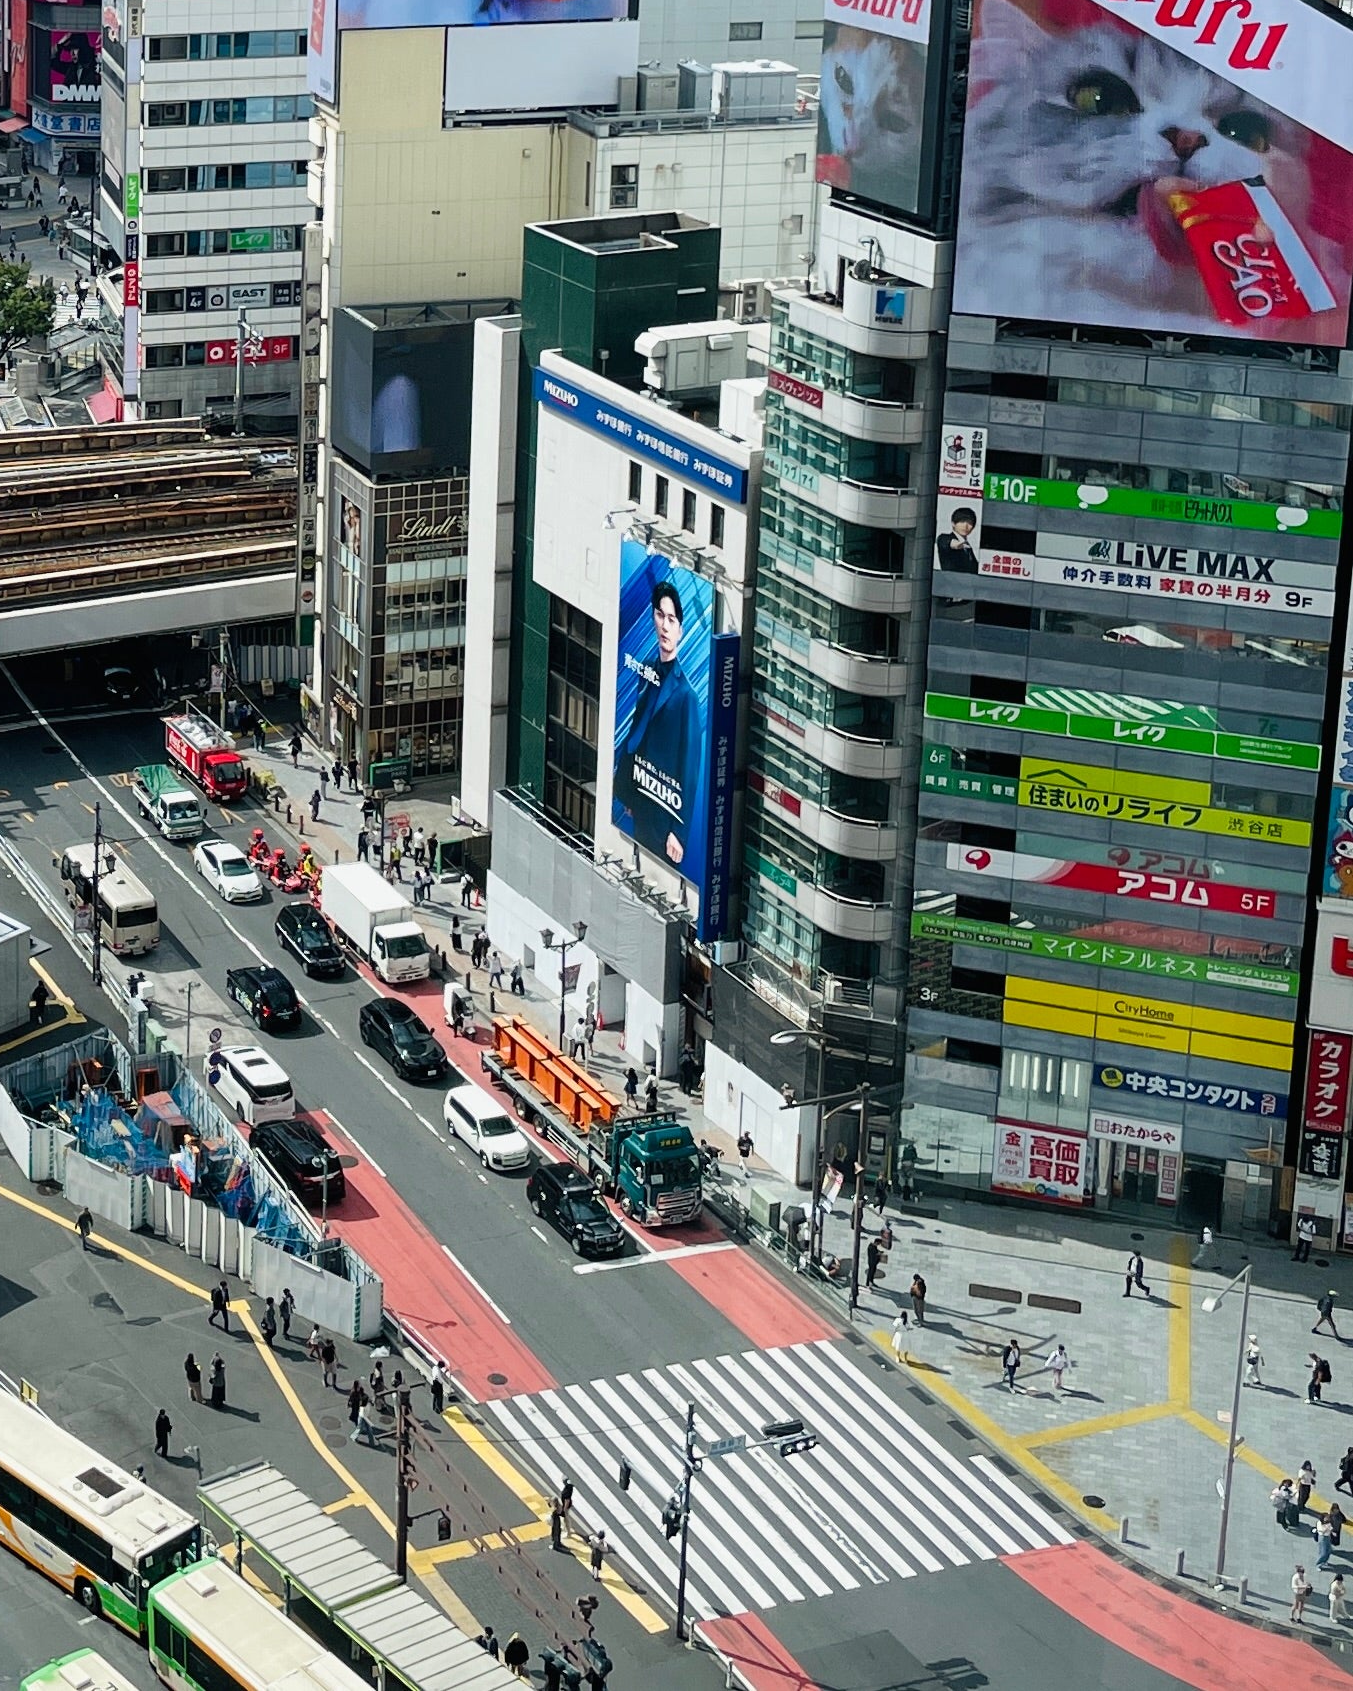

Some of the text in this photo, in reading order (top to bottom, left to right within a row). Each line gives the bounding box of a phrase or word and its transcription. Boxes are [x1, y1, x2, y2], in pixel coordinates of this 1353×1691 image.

[236, 233, 265, 245] レイク
[1213, 233, 1273, 317] CIAO
[190, 297, 203, 308] 4F
[273, 344, 289, 354] 3F
[543, 379, 579, 407] MIZUHO
[596, 410, 734, 488] みずほ銀行 みずほ信託銀行 みずほ証券
[969, 430, 983, 487] お部屋探しは
[1000, 477, 1037, 503] 10F
[397, 515, 458, 539] Lindt
[1116, 542, 1276, 583] LiVE MAX
[1062, 566, 1313, 609] 仲介手数料 家賃の半月分 9F
[721, 656, 734, 708] MIZUHO
[970, 702, 1021, 723] レイク
[1258, 718, 1279, 735] 7F
[1114, 721, 1166, 742] レイク
[716, 736, 728, 787] みずほ証券
[929, 750, 946, 763] 6F
[633, 764, 682, 810] MIZUHO
[1029, 784, 1283, 838] 住まいのリライフ 渋谷店
[1138, 851, 1210, 879] アコム
[709, 874, 721, 926] みずほ銀行
[1117, 871, 1271, 911] アコム 5F
[1042, 937, 1198, 976] マインドフルネス
[920, 988, 939, 1002] 3F
[1114, 1000, 1174, 1021] CityHome
[1125, 1071, 1276, 1115] 中央コンタクト 2F
[1313, 1041, 1343, 1118] カラオケ
[1005, 1131, 1021, 1147] 金
[1110, 1122, 1176, 1144] おたからや
[1030, 1135, 1081, 1164] 高価
[1028, 1158, 1080, 1187] 買取
